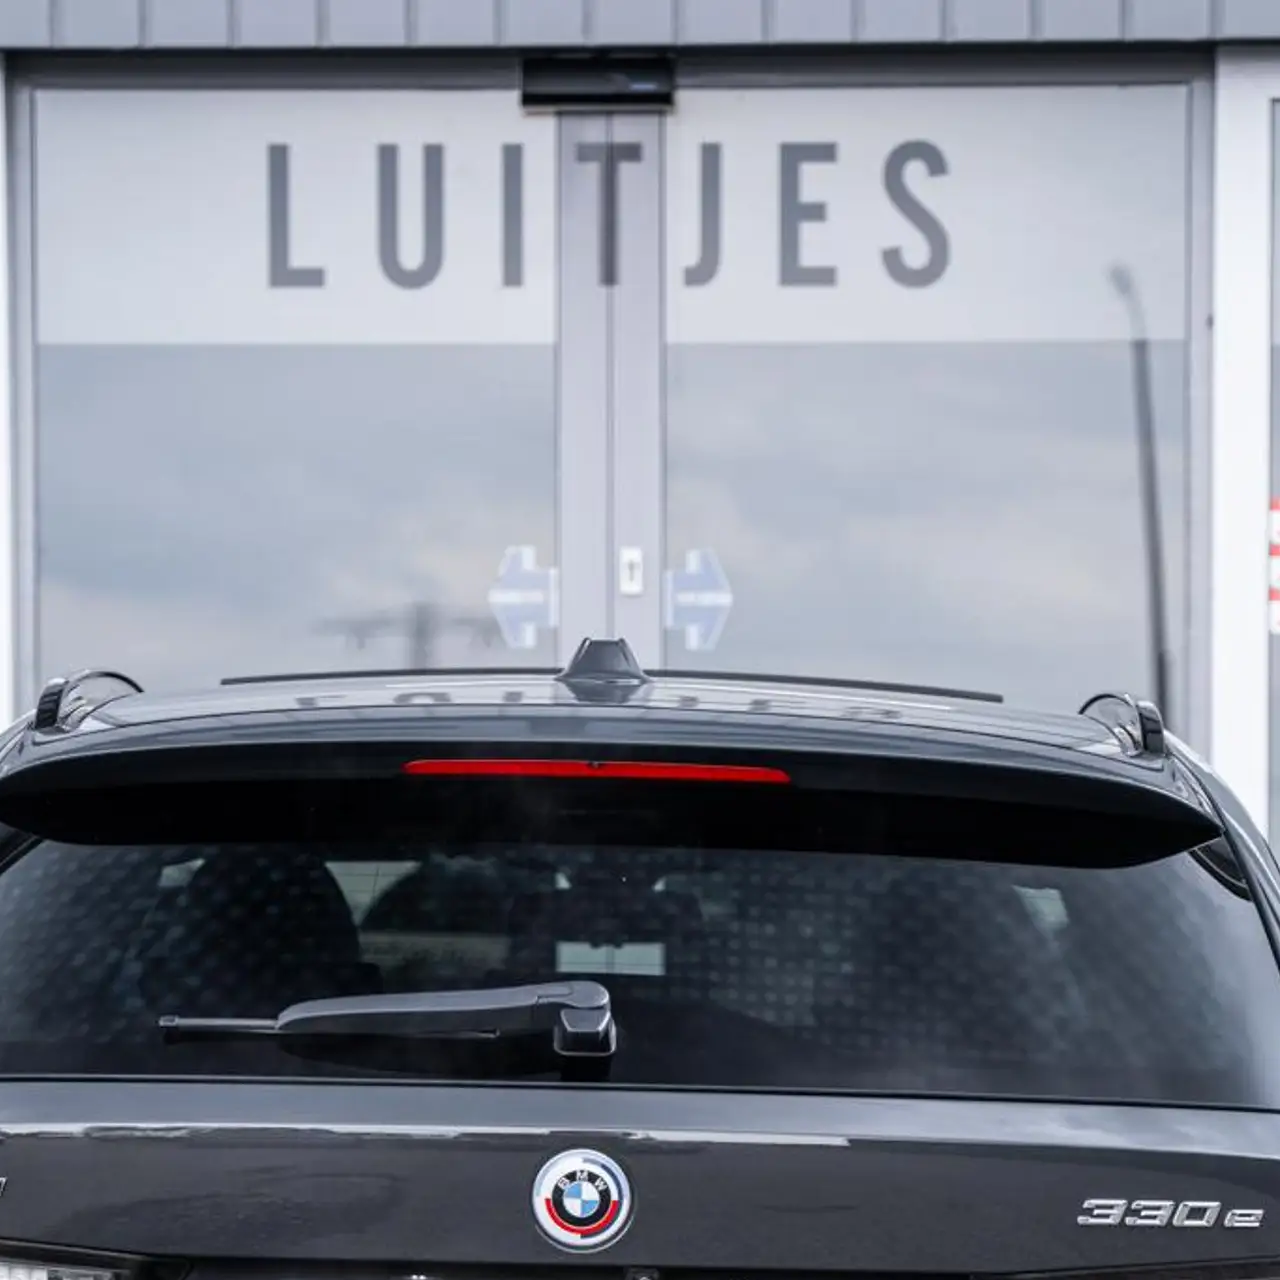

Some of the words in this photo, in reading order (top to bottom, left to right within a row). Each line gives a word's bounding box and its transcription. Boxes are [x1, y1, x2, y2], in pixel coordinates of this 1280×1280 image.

[267, 140, 951, 290] LUITJES
[557, 1169, 608, 1191] BMW
[1076, 1198, 1265, 1229] 330e
